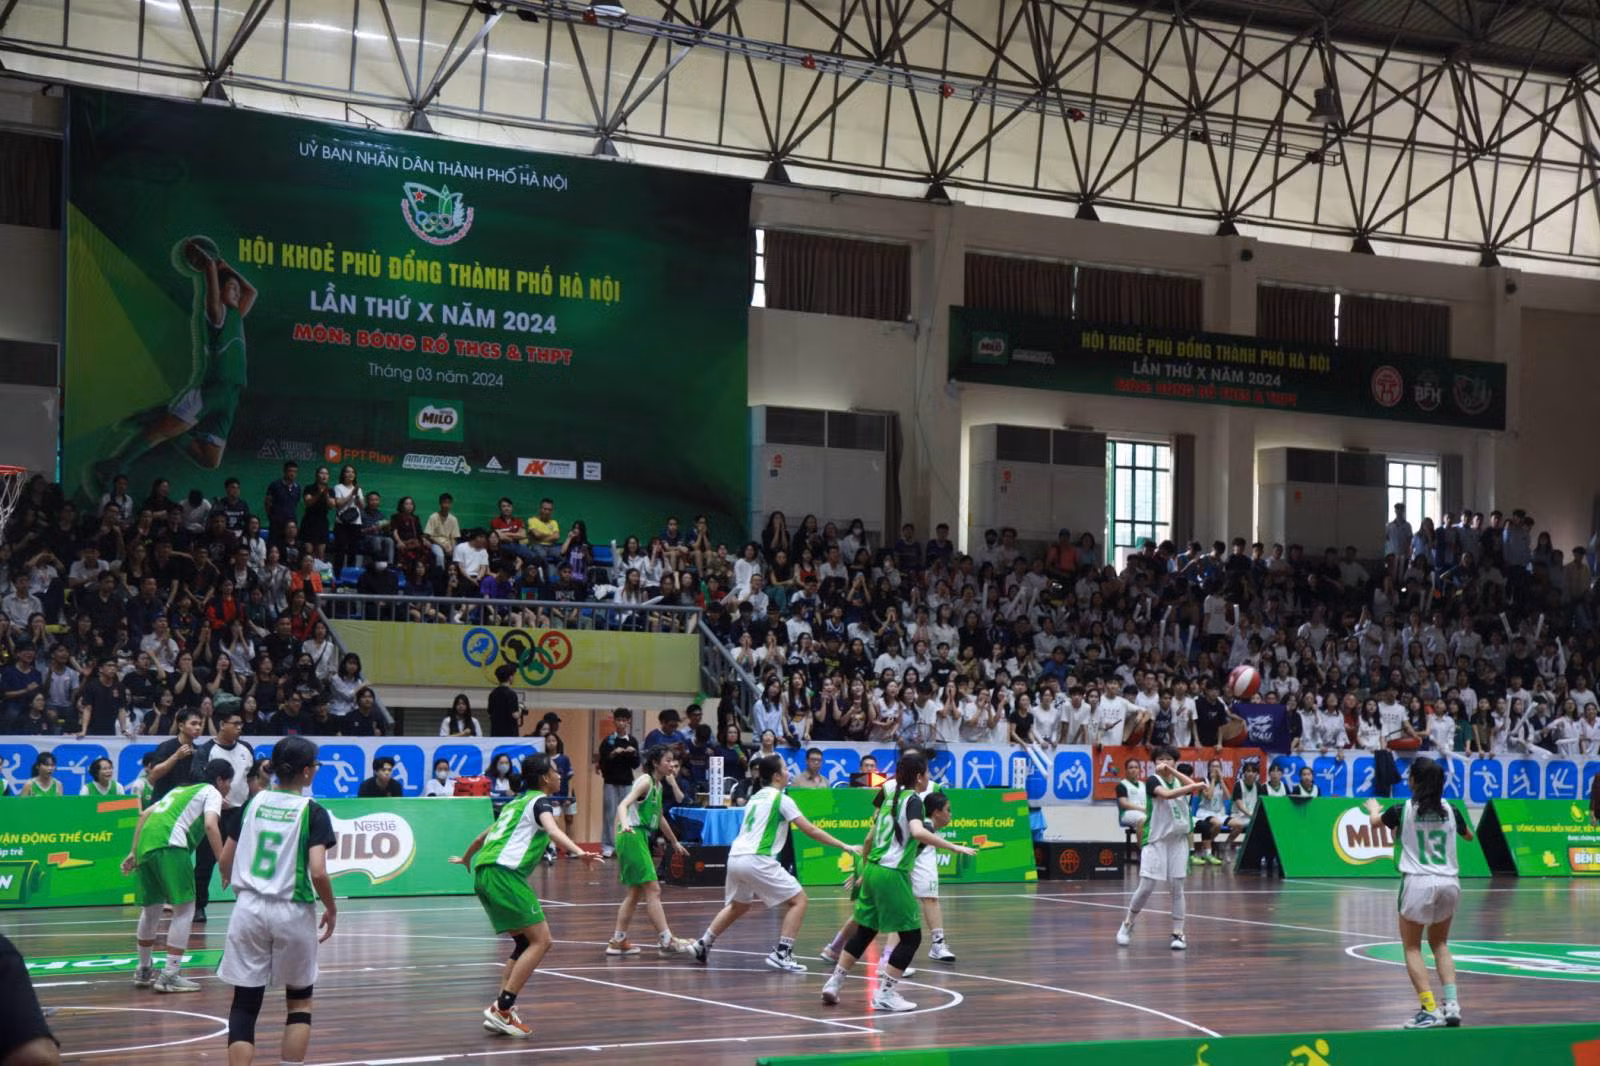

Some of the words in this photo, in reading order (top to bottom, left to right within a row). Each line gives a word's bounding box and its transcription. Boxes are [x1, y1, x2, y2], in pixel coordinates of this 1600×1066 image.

[322, 145, 352, 163] BAN
[356, 150, 398, 169] NHÂN
[402, 156, 434, 173] DÂN
[438, 161, 483, 180] THÀNH
[487, 167, 517, 184] PHỐ
[520, 171, 540, 187] HÀ
[543, 174, 568, 192] NỘI
[239, 235, 273, 269] HỘI
[281, 241, 334, 273] KHOẺ
[342, 249, 381, 278] PHÙ
[449, 261, 510, 292] THÀNH
[516, 265, 553, 296] PHỐ
[560, 272, 583, 299] HÀ
[590, 275, 620, 306] NỘI
[310, 282, 356, 315] LẦN
[364, 294, 411, 321] THỨ
[416, 302, 434, 324] X
[442, 302, 496, 330] NĂM
[503, 310, 557, 335] 2024
[292, 322, 351, 346] MÔN:
[356, 328, 416, 352] BÓNG
[454, 338, 502, 360] THCS
[506, 344, 522, 361] &
[526, 345, 573, 366] THPT
[368, 362, 413, 383] Tháng
[416, 367, 433, 381] 03
[437, 369, 469, 385] năm
[472, 372, 504, 387] 2024
[1196, 366, 1208, 380] X
[1211, 367, 1244, 384] NĂM
[1248, 372, 1281, 387] 2024
[422, 411, 454, 426] MILO
[344, 448, 367, 461] FPT
[369, 450, 397, 464] Play
[839, 819, 860, 829] MILO
[1346, 824, 1395, 848] MIL
[21, 832, 57, 845] ĐỘNG
[82, 829, 113, 843] CHẤT
[1416, 829, 1447, 865] 13
[251, 831, 283, 879] 6
